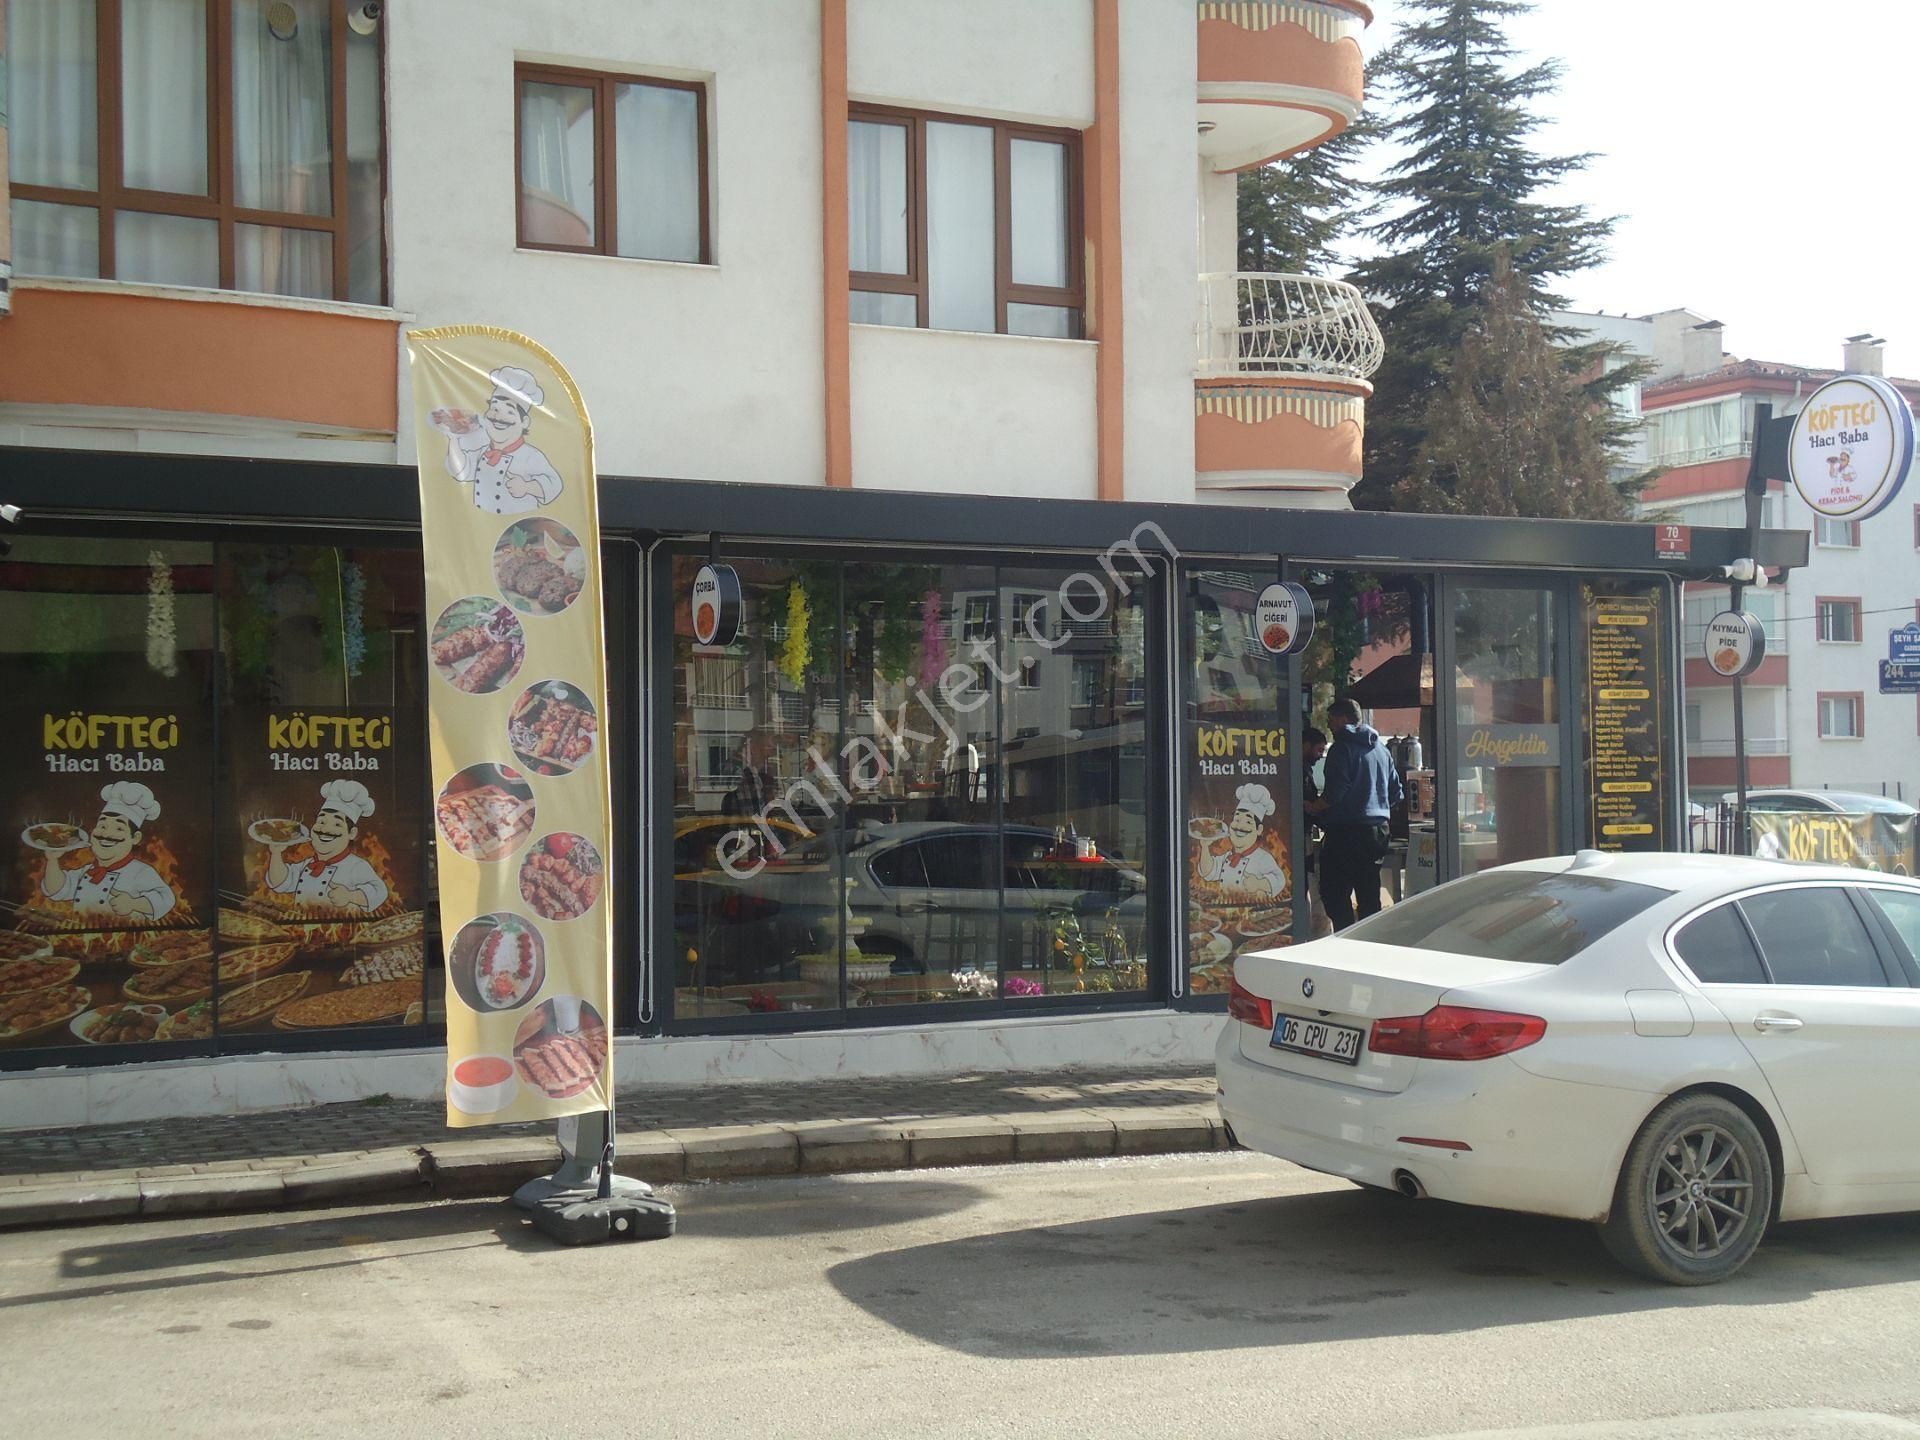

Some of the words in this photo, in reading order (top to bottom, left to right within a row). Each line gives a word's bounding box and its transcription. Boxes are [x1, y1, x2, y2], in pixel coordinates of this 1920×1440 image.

[1809, 434, 1836, 448] Hacı
[1838, 428, 1869, 445] Baba
[695, 580, 715, 597] ÇORBA
[1259, 600, 1292, 608] ARNAVUT
[1712, 624, 1746, 634] KIYMALI
[1719, 637, 1738, 647] PİDE
[45, 753, 100, 772] Hacı
[105, 752, 166, 772] Baba
[270, 752, 320, 771] Hacı
[324, 751, 380, 771] Baba
[1199, 760, 1235, 775] Hacı
[1238, 759, 1278, 775] Baba
[1281, 1020, 1299, 1042] 06
[1303, 1024, 1329, 1049] CPU
[1333, 1031, 1358, 1056] 231
